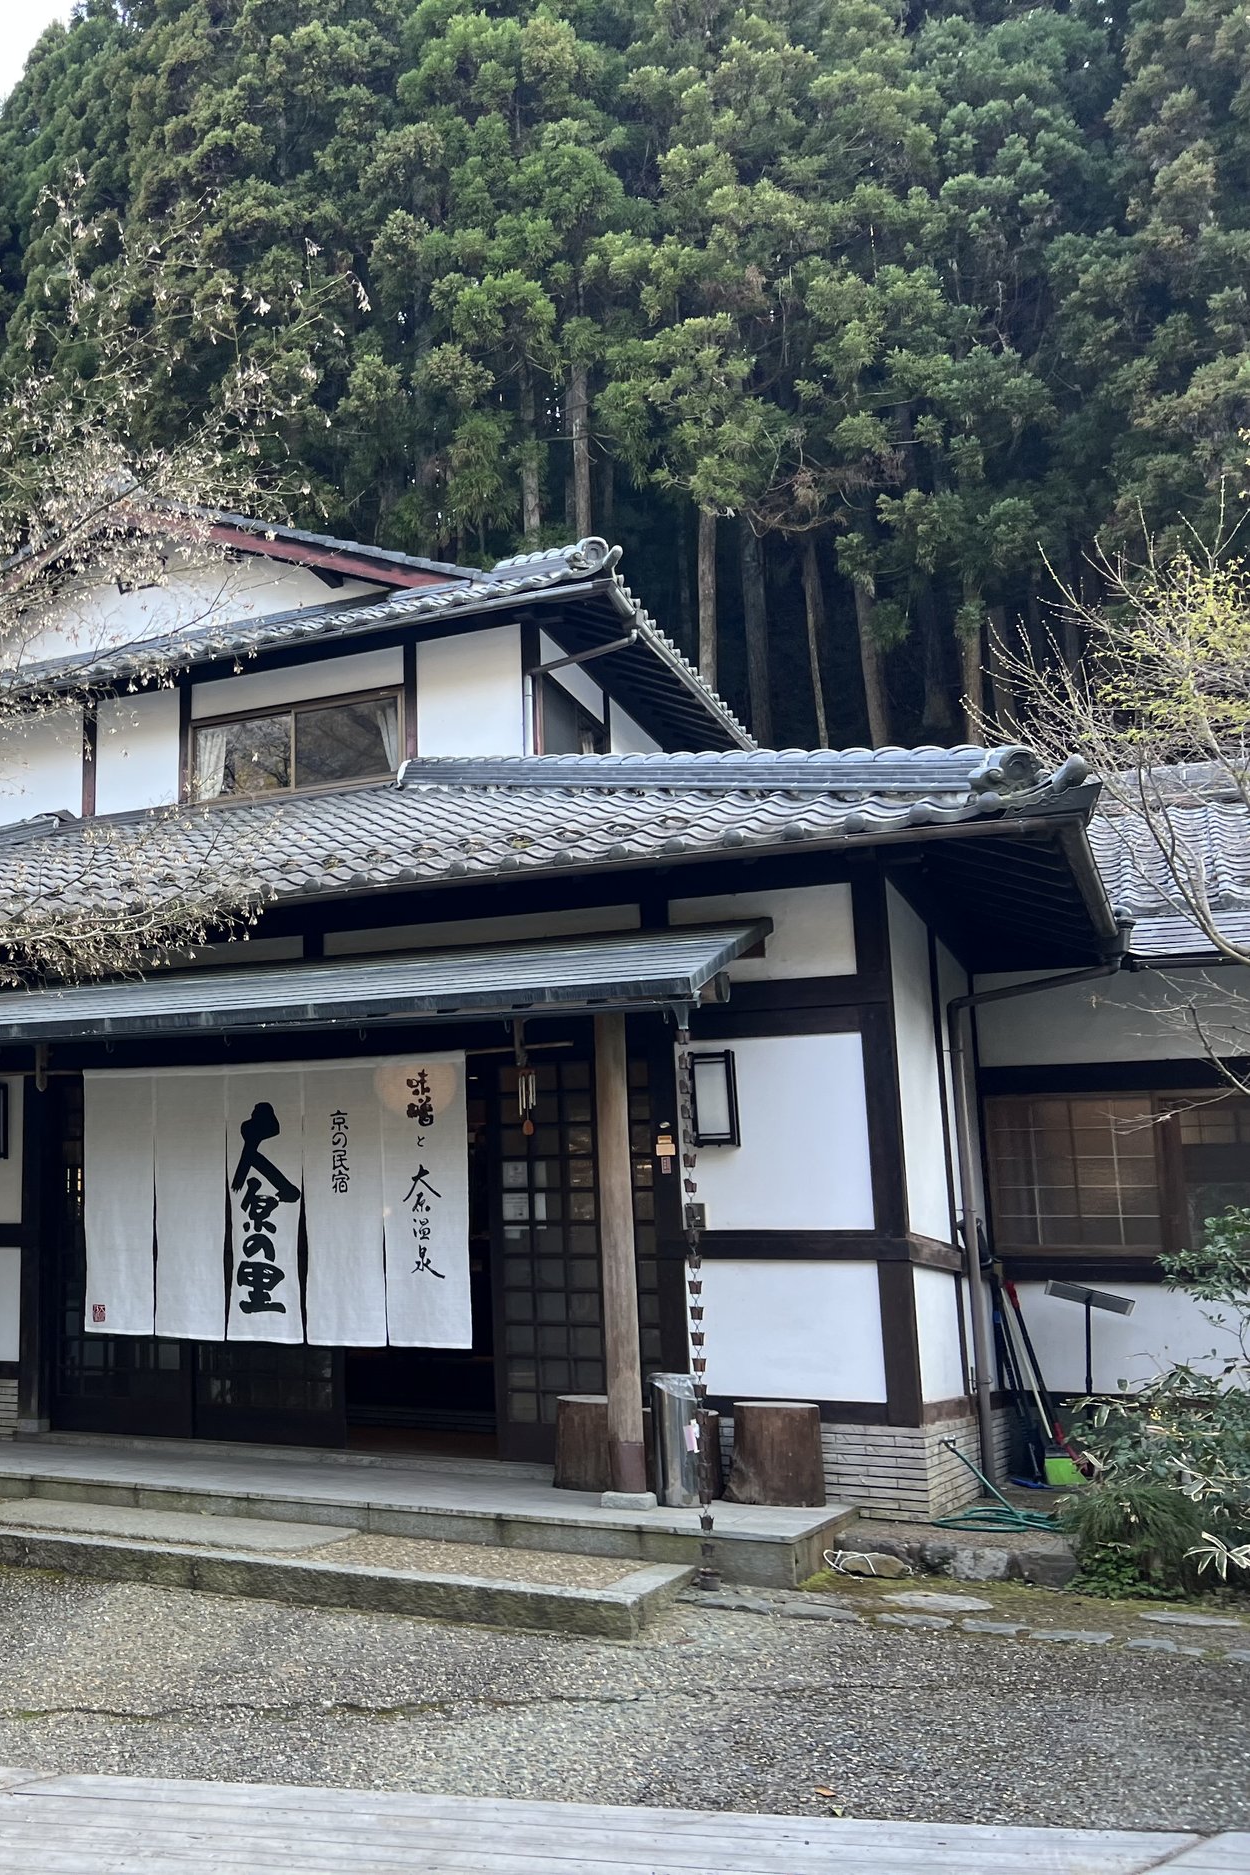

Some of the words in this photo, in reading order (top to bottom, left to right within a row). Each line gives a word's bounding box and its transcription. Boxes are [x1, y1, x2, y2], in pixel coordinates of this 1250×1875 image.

[231, 1101, 301, 1315] 大原の里
[329, 1109, 351, 1194] 京の民宿
